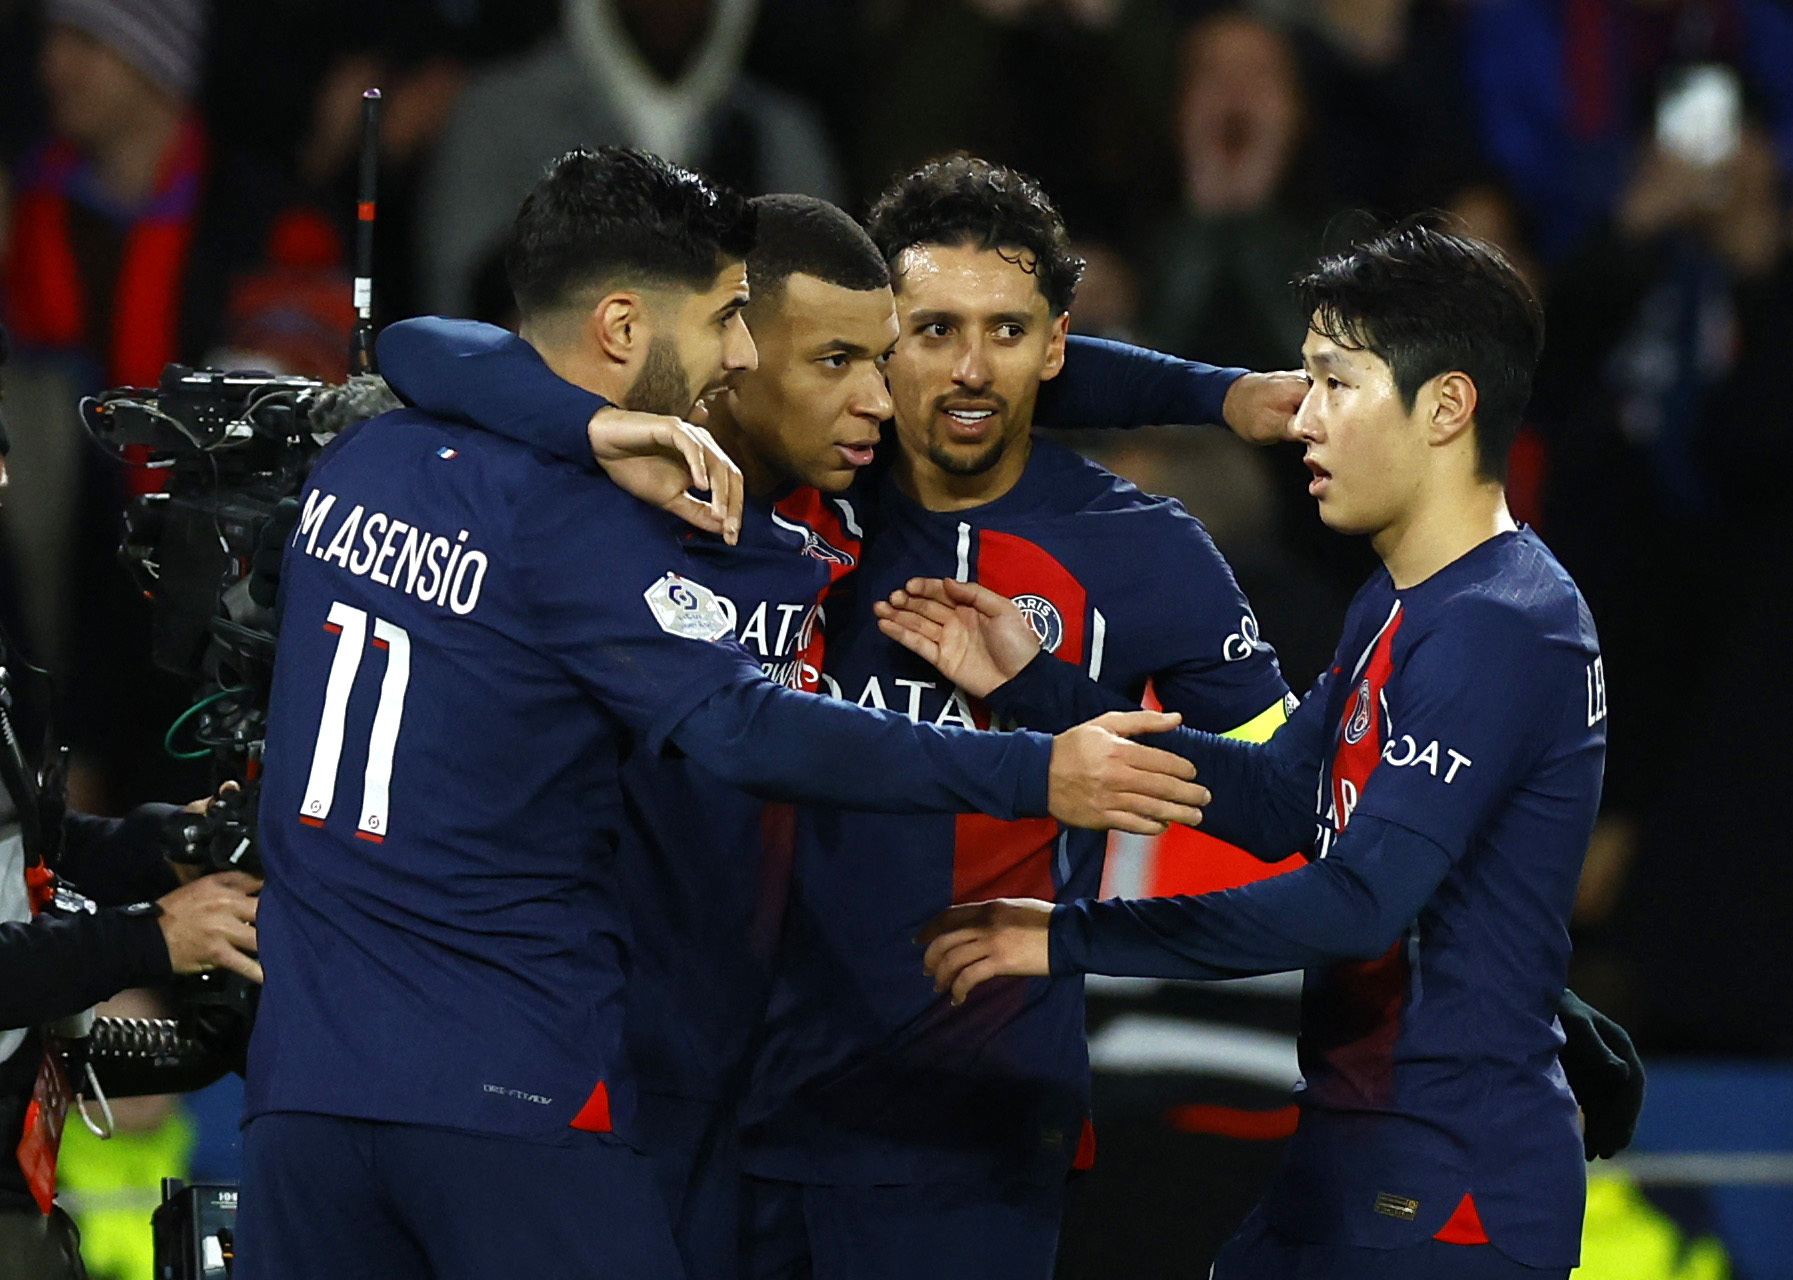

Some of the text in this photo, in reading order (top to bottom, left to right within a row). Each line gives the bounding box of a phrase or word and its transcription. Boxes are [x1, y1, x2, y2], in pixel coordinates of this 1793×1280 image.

[292, 488, 488, 615] M.ASENSIO
[1018, 598, 1052, 617] ARIS
[300, 601, 411, 843] 11
